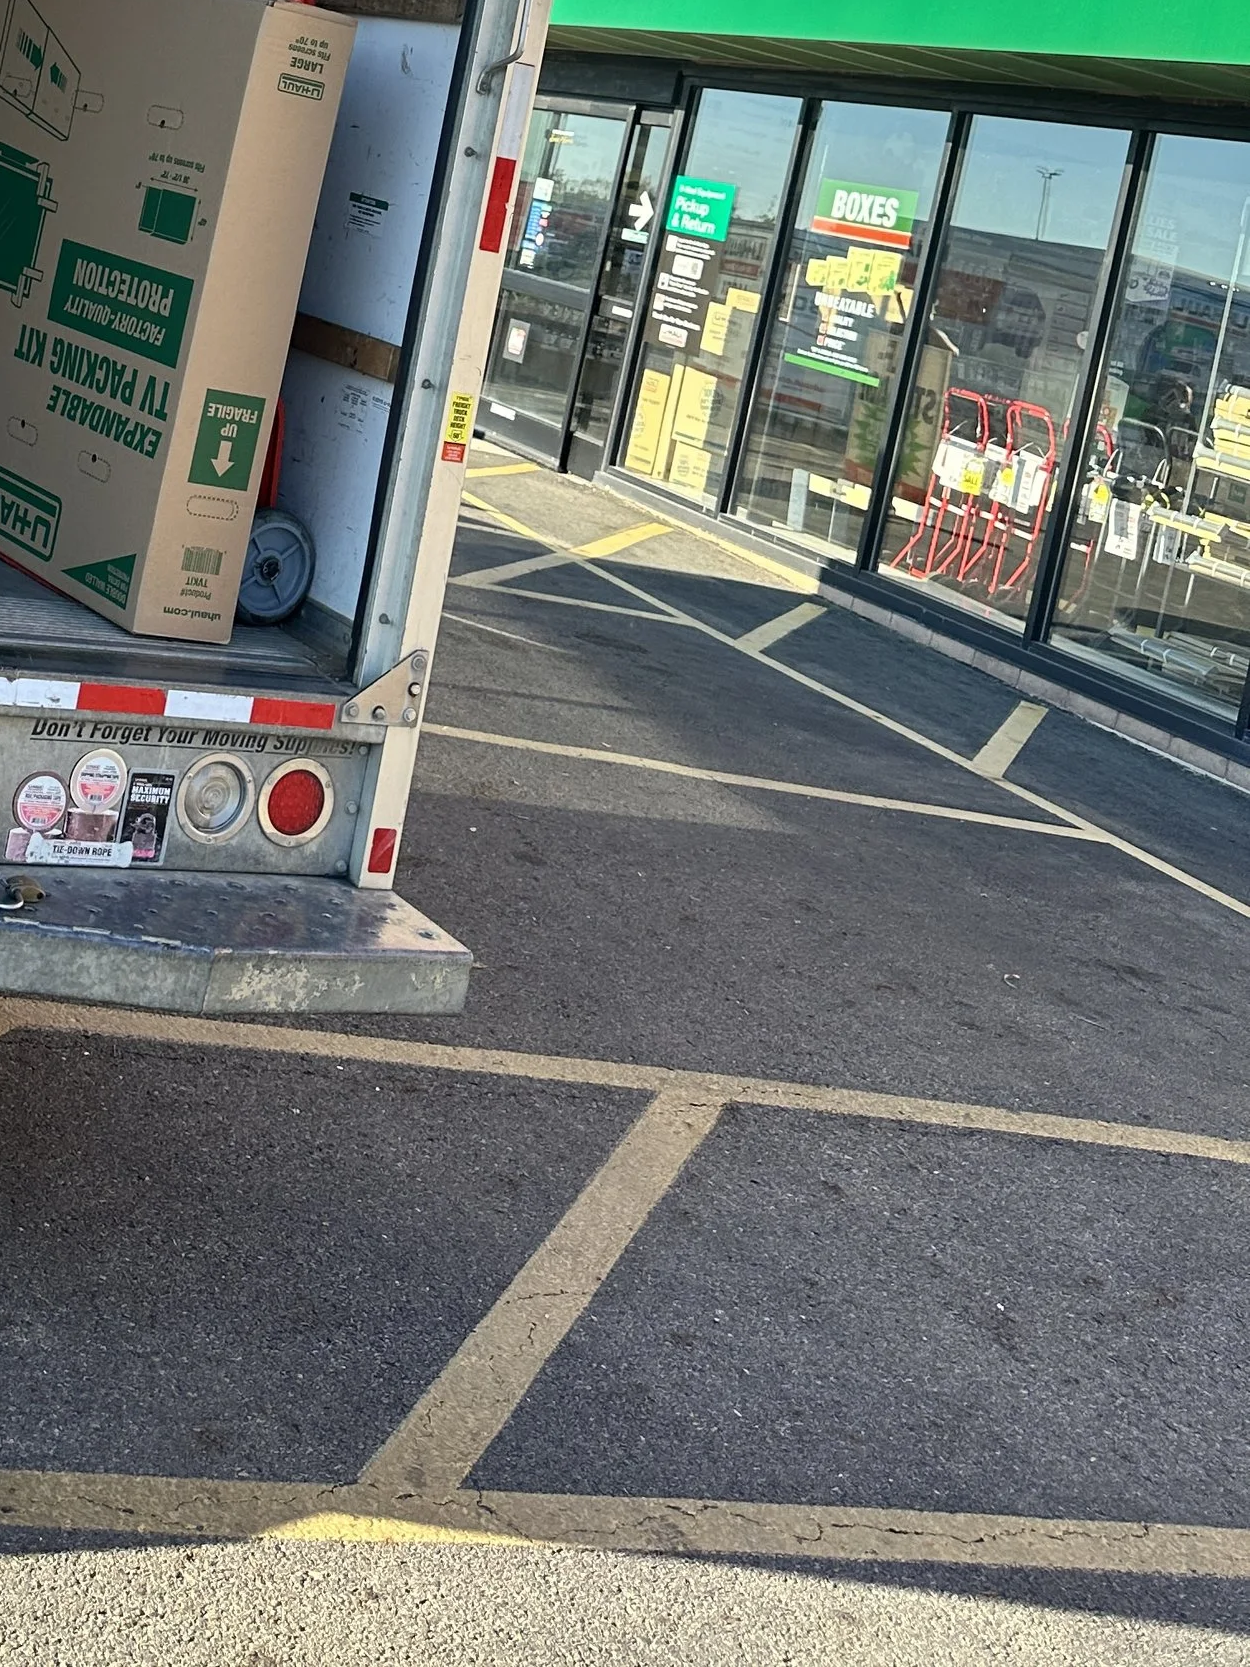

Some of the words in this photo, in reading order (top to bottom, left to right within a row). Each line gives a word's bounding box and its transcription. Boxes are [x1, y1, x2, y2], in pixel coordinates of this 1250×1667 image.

[288, 43, 316, 56] screens
[317, 51, 331, 61] Fits
[290, 56, 324, 74] LARGE
[281, 80, 321, 97] U-HAUL
[674, 195, 710, 218] Pickup
[830, 189, 900, 228] BOXES
[681, 214, 717, 235] Return
[72, 258, 174, 318] PROTECTION
[64, 294, 166, 346] FACTORY-QUALITY
[13, 324, 48, 368] KIT
[49, 336, 139, 407] PACKING
[139, 374, 171, 422] TV
[45, 384, 163, 459] EXPANDABLE
[207, 402, 258, 424] FRAGILE
[220, 423, 238, 438] UP
[185, 577, 208, 588] TVKIT
[163, 606, 221, 621] uhaul.com
[31, 719, 86, 736] Don't
[90, 722, 152, 745] Forget
[156, 725, 199, 745] Your
[202, 729, 269, 753] Moving
[130, 794, 170, 804] SECURITY
[131, 785, 171, 796] MAXIMUM
[52, 845, 91, 855] TIE-DOWN
[91, 847, 112, 857] ROPE
